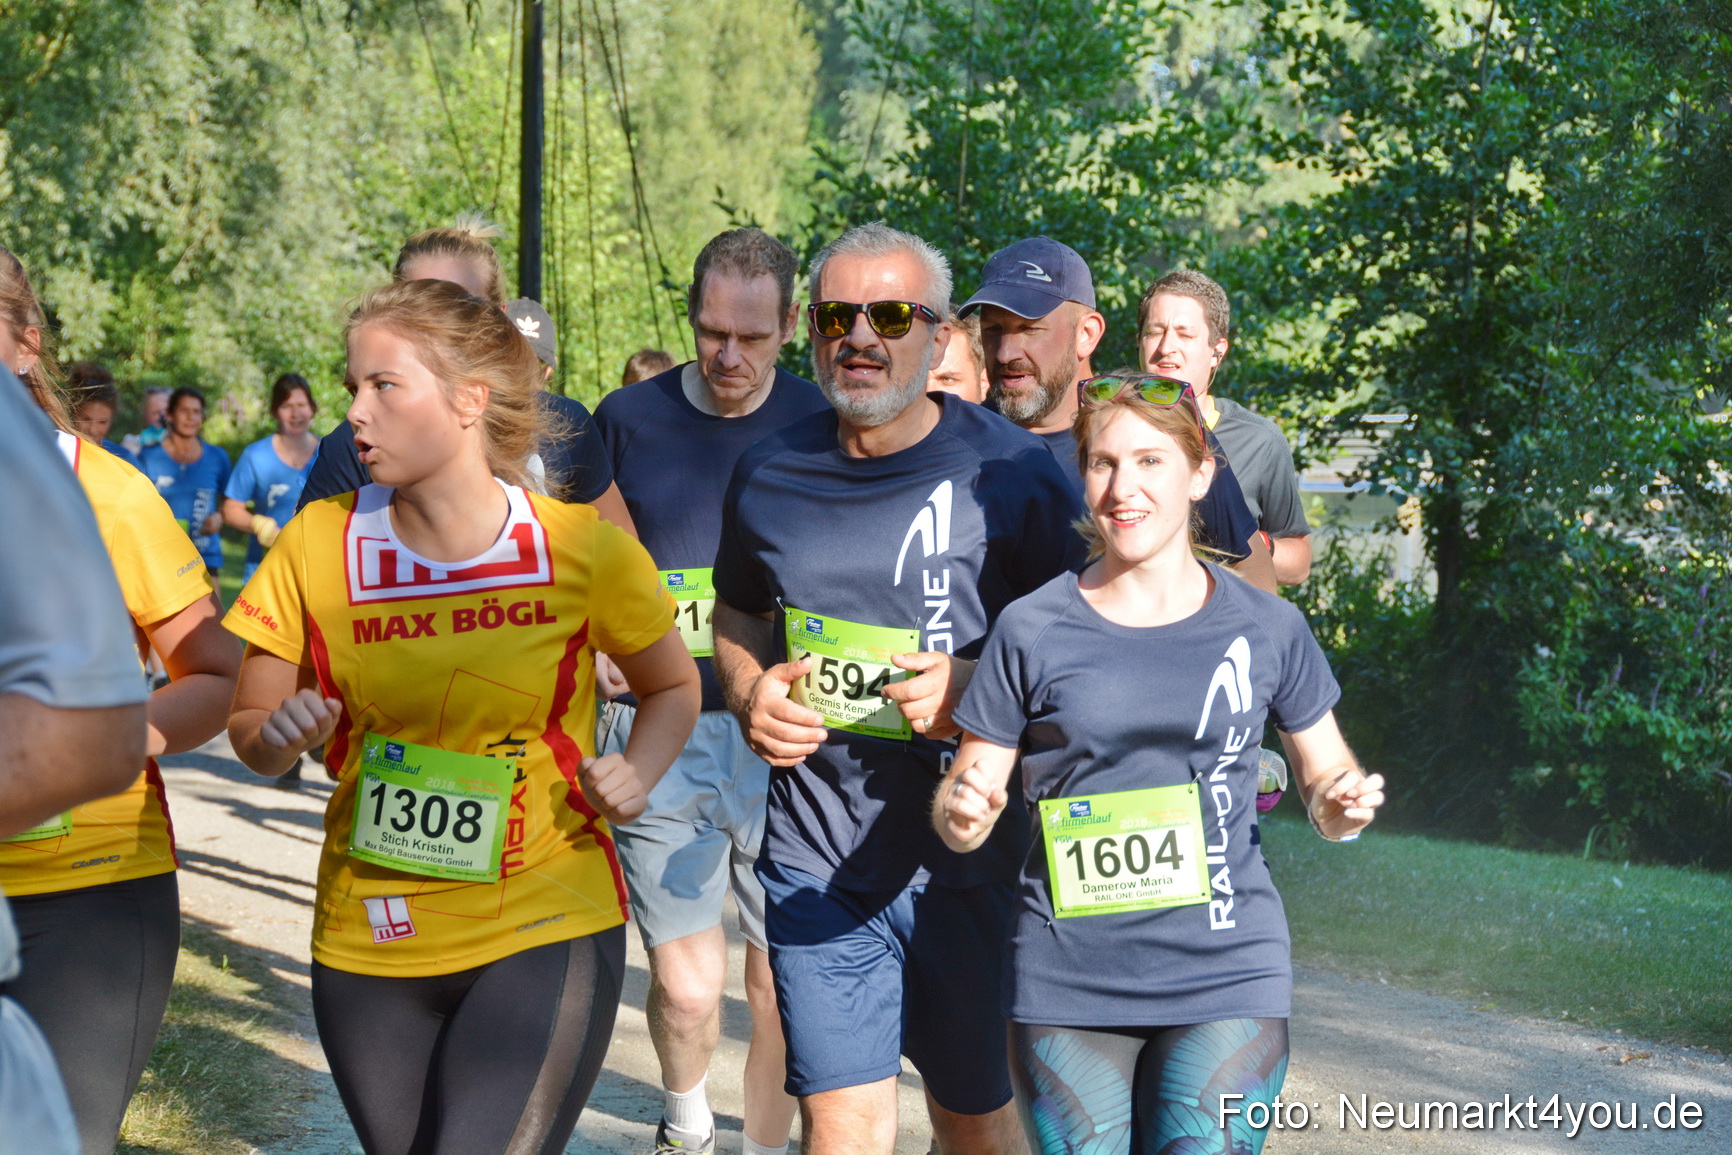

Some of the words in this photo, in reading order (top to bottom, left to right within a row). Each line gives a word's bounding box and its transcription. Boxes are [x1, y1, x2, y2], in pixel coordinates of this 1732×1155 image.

[665, 582, 699, 592] rmenlauf
[352, 612, 438, 645] MAX
[452, 597, 557, 634] BÖGL
[799, 628, 839, 646] firmenlauf
[843, 646, 868, 659] 2018
[799, 651, 891, 706] 1594
[808, 692, 841, 710] Gezmis
[844, 702, 877, 717] Kemal
[845, 711, 868, 724] GmbH
[375, 756, 422, 775] firmenlauf
[425, 777, 455, 790] 2018
[370, 782, 483, 844] 1308
[1061, 812, 1112, 827] firmenlauf
[1119, 817, 1149, 830] 2018
[381, 832, 408, 847] Stich
[412, 839, 454, 855] Kristin
[365, 840, 377, 849] Max
[379, 845, 395, 856] Bögl
[397, 848, 443, 864] Bauservice
[445, 857, 473, 868] GmbH
[1066, 829, 1184, 881] 1604
[1082, 881, 1137, 894] Damerow
[1141, 876, 1173, 888] Maria
[1136, 888, 1162, 897] GmbH
